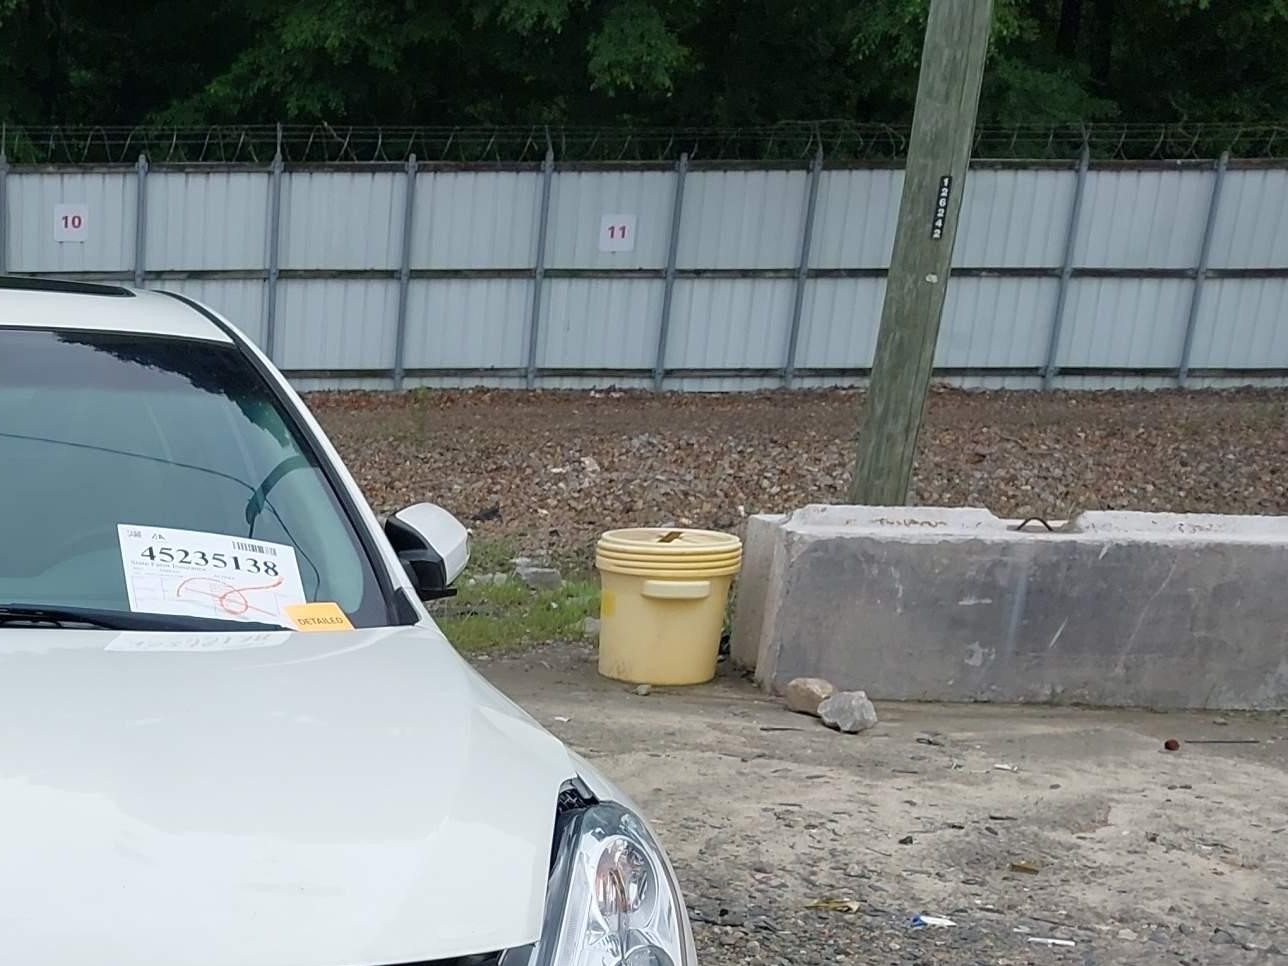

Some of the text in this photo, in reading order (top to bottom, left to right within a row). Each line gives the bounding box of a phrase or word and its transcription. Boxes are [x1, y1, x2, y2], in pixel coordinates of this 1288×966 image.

[932, 178, 949, 239] 126242
[61, 215, 82, 229] 10
[607, 225, 626, 239] 11
[140, 545, 280, 577] 45235138
[297, 616, 344, 626] DETAILED
